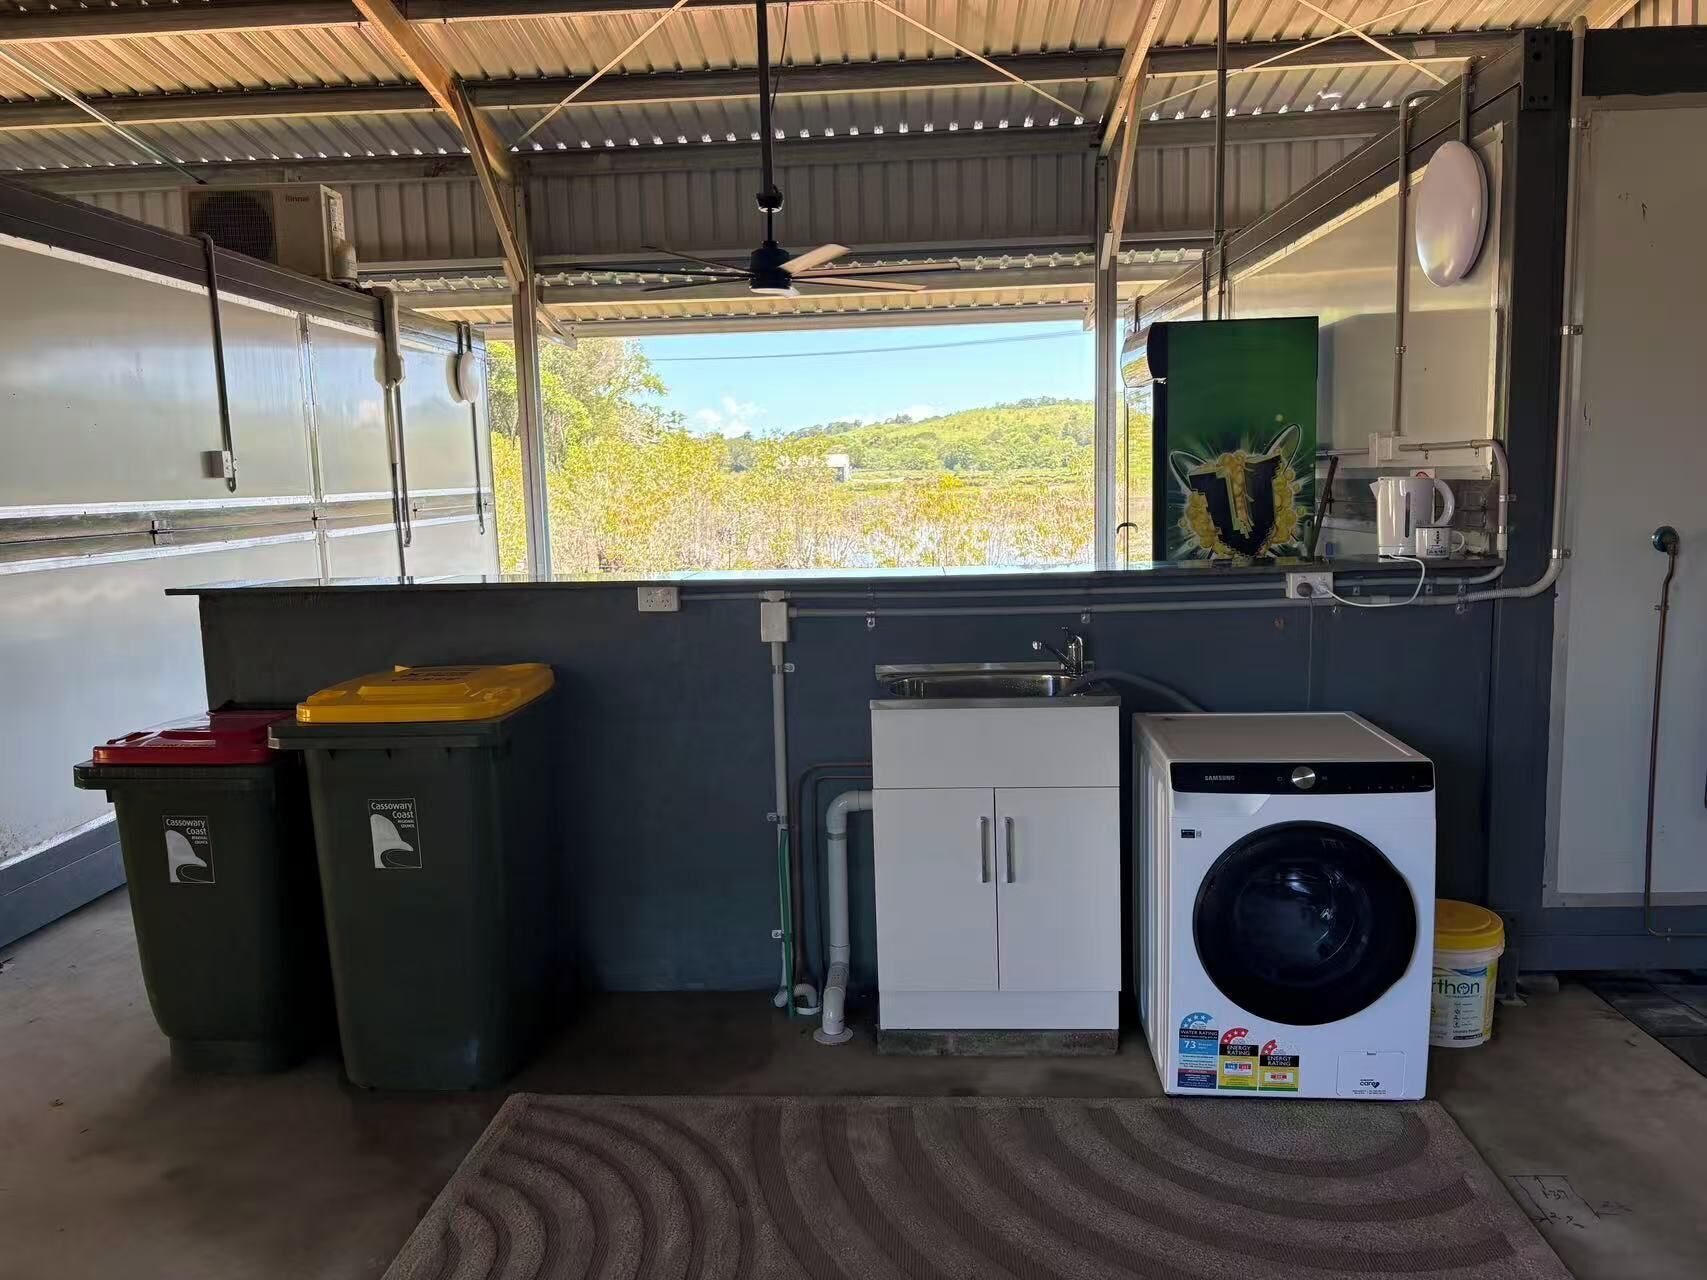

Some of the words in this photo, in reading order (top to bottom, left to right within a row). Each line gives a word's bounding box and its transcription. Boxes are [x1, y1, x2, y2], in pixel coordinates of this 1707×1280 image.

[371, 802, 412, 811] Cassowary
[392, 810, 414, 819] Coast
[165, 818, 206, 828] Cassowary
[186, 827, 207, 835] Coast
[1184, 1040, 1197, 1049] 73
